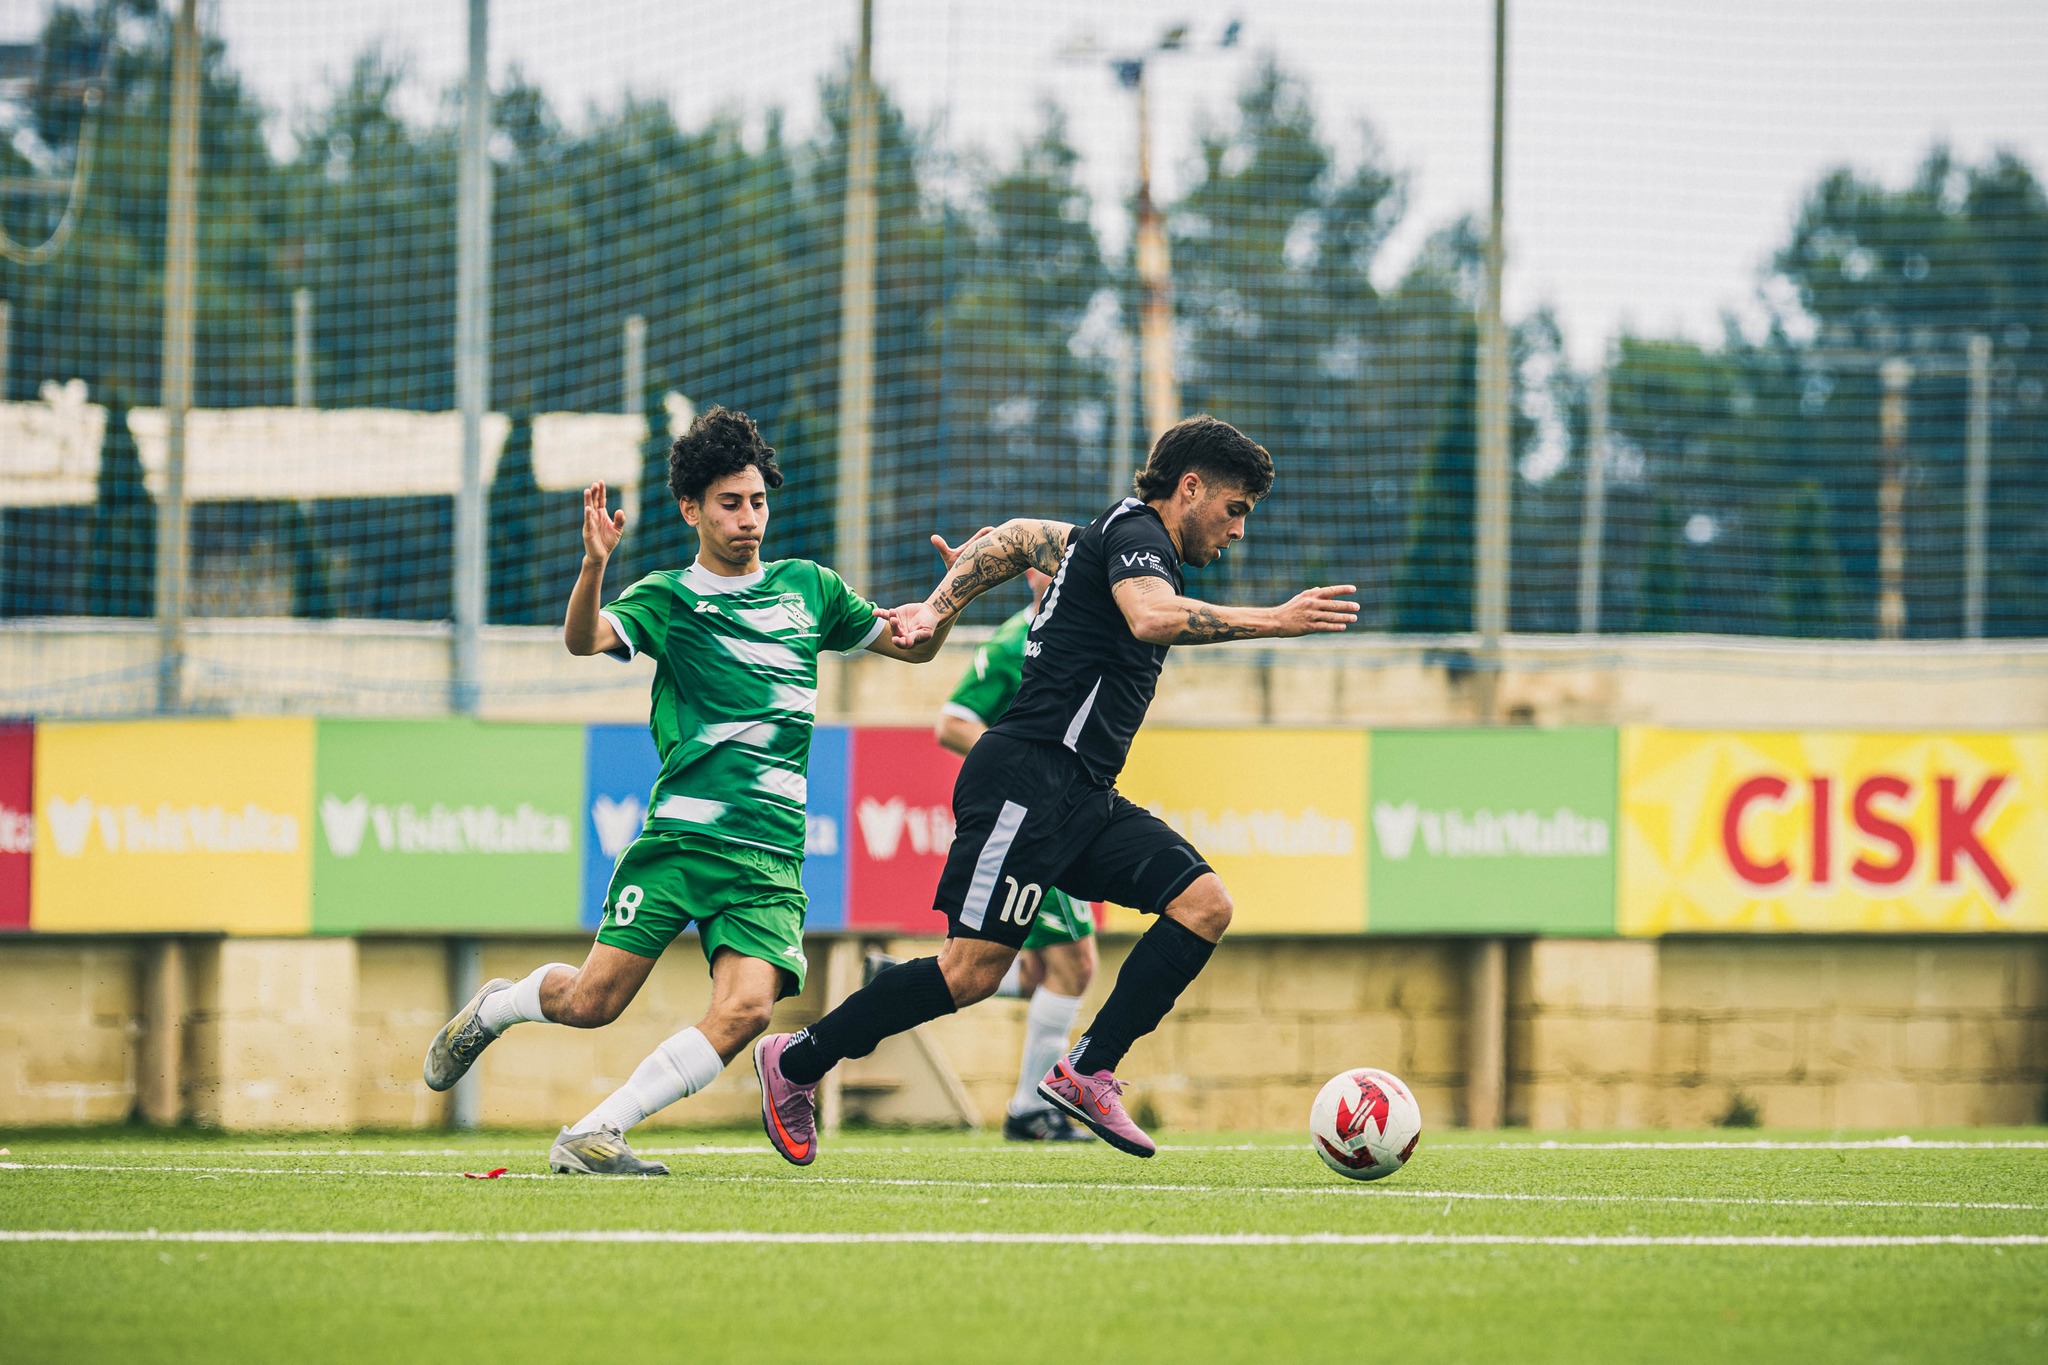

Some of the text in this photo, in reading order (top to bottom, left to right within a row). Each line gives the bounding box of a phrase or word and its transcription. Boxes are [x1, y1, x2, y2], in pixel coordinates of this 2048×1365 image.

[1722, 775, 2017, 902] CISK
[615, 885, 644, 926] 8
[999, 875, 1042, 926] 10
